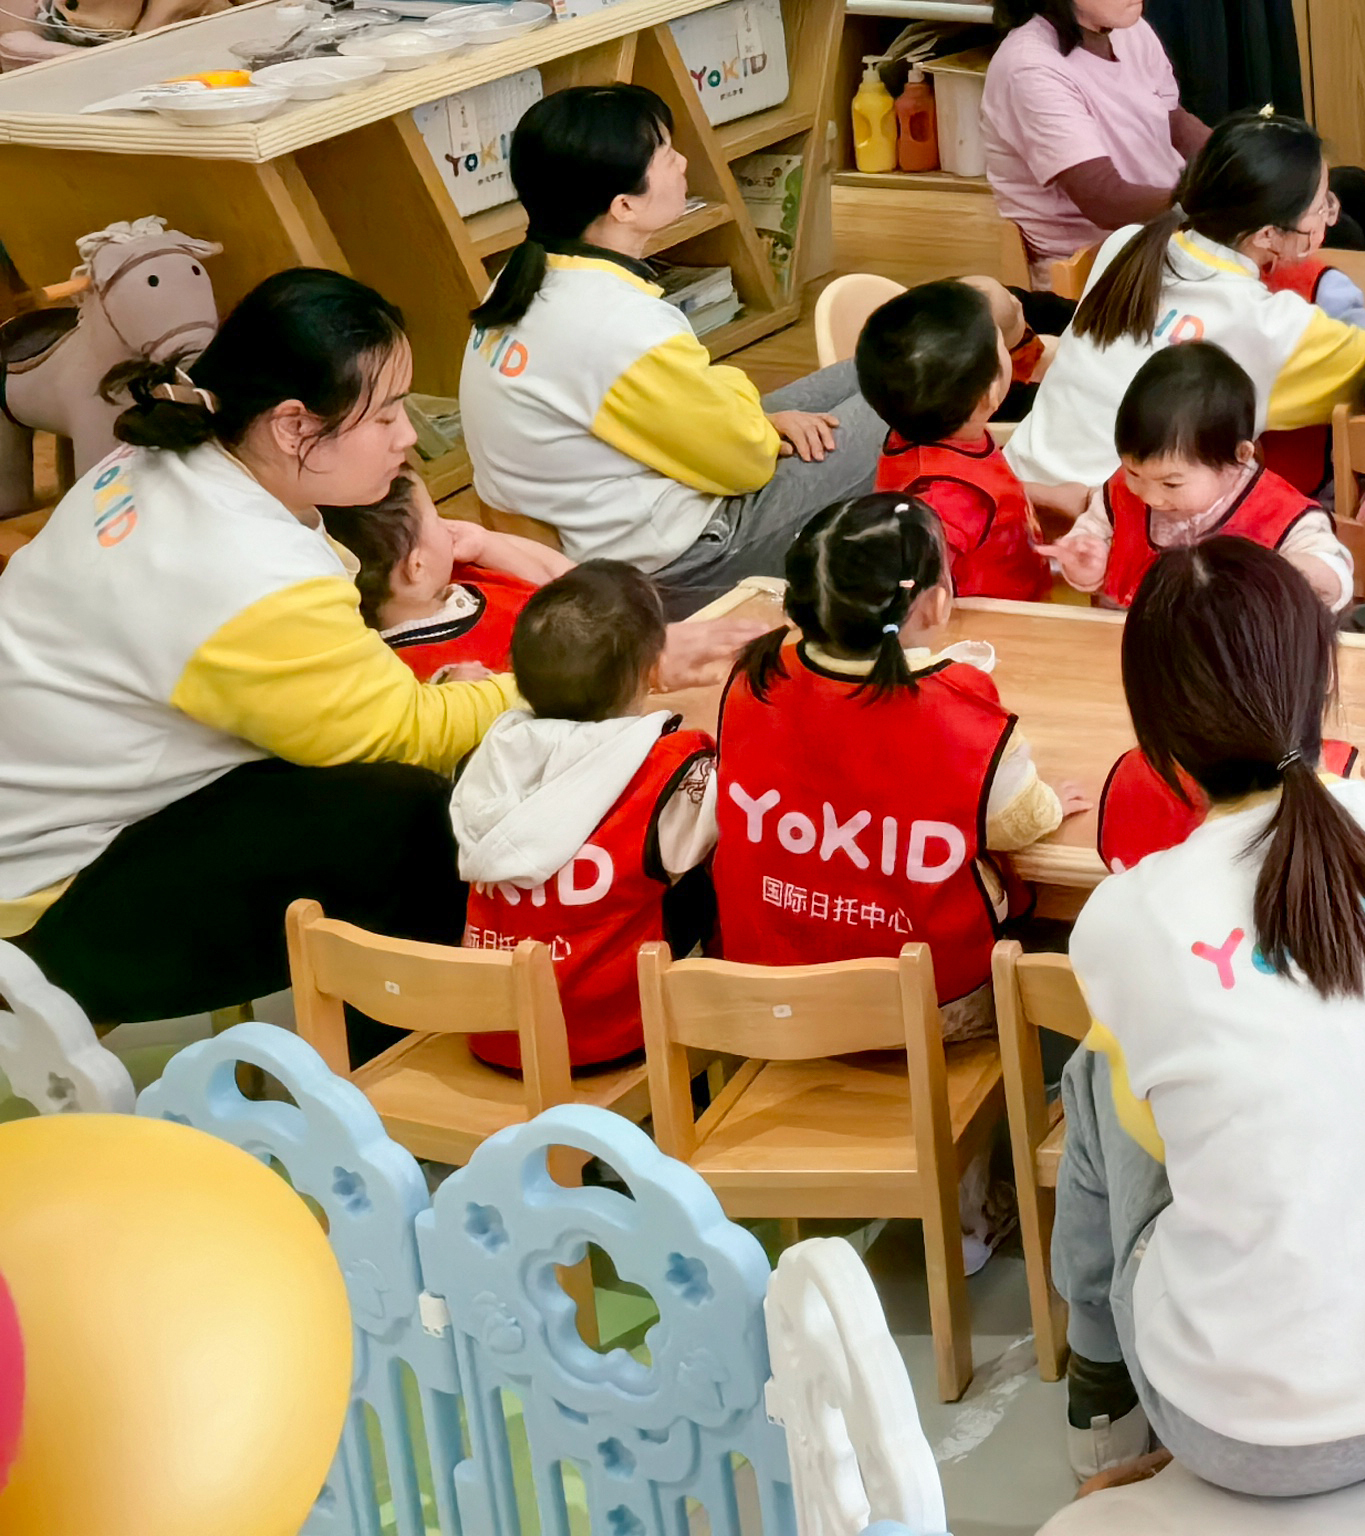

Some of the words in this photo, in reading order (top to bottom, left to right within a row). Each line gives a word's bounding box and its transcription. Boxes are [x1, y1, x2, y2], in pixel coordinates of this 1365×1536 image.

[689, 52, 768, 92] YoKID
[444, 129, 511, 178] YoKI
[472, 325, 529, 378] oKID
[728, 781, 964, 885] YoKID
[760, 874, 915, 938] 国际日托中心
